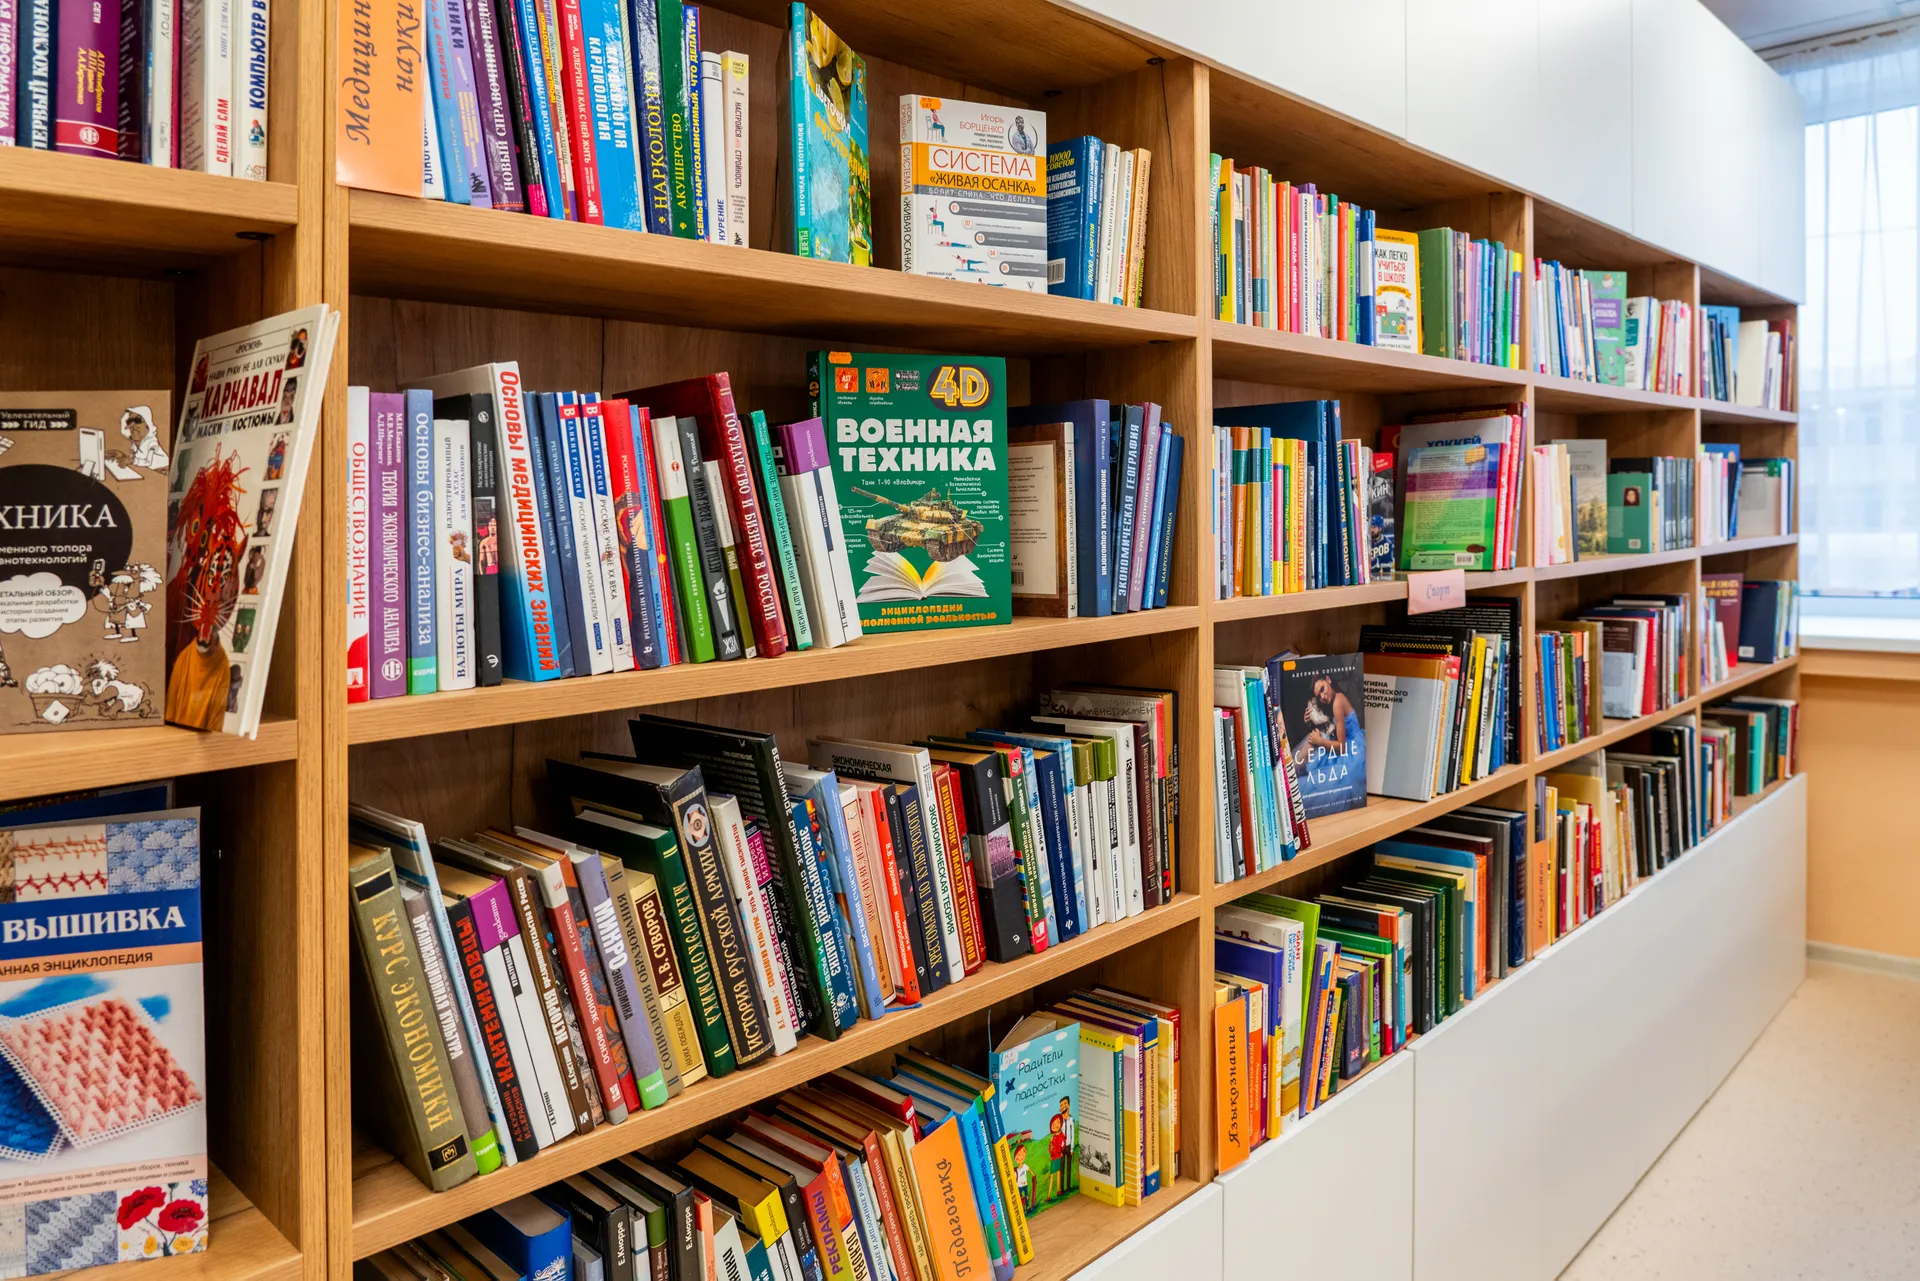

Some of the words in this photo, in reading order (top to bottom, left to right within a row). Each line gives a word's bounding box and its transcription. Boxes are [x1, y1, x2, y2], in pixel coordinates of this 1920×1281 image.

[396, 2, 422, 94] науки
[687, 13, 699, 63] ДЕЛАТЬ?
[249, 13, 266, 110] КОМПЬЮТЕР
[572, 46, 584, 88] АЛЛЕРГИЯ
[690, 64, 699, 87] ЧТО
[217, 98, 229, 116] САМ
[486, 42, 507, 137] СПРАВОЧНИК
[578, 97, 586, 112] КАК
[588, 36, 611, 141] КАРДИОЛОГИЯ
[606, 46, 628, 149] КАРДИОЛОГИЯ
[216, 118, 229, 163] СДЕЛАЙ
[540, 109, 553, 156] ВОЗРАСТА
[580, 121, 589, 138] НЕЙ
[645, 70, 668, 211] НАРКОЛОГИЯ
[734, 101, 742, 138] НАСТРОЙСЯ
[959, 121, 1004, 134] БОРЩЕНКО
[980, 113, 1005, 124] Игорь
[499, 141, 515, 191] НОВЫЙ
[583, 139, 592, 163] ЖИТЬ
[671, 112, 687, 209] АКУШЕРСТВО
[689, 91, 703, 202] НАРКОЗАВИСИМЫЙ.
[902, 147, 911, 191] СИСТЕМА
[932, 148, 1033, 178] СИСТЕМА
[734, 150, 742, 189] СТРОЙНОСТЬ
[929, 172, 979, 189] «ЖИВАЯ
[981, 177, 1036, 194] ОСАНКА»
[928, 187, 955, 196] БОЛИТ
[990, 193, 1005, 201] ЧТО
[1007, 195, 1036, 204] ДЕЛАТЬ
[696, 202, 705, 236] СЕМЬЕ
[717, 198, 726, 241] КУРЕНИЕ
[1377, 260, 1406, 272] УЧИТЬСЯ
[1378, 272, 1383, 281] В
[1384, 272, 1406, 283] ШКОЛЕ
[1388, 249, 1408, 261] ЛЕГКО
[208, 369, 225, 382] НАШИ
[227, 363, 241, 377] РУКИ
[242, 361, 251, 373] НЕ
[251, 357, 264, 371] ДЛЯ
[264, 352, 286, 369] СКУКИ
[929, 364, 990, 407] 4D
[1, 410, 71, 421] Увлекательный
[201, 368, 284, 420] КАРНАВАЛ
[22, 419, 47, 429] ГИД
[197, 418, 223, 439] МАСКИ
[231, 410, 276, 433] КОСТЮМЫ
[836, 418, 993, 443] ВОЕННАЯ
[1426, 435, 1482, 449] ХОККЕЙ
[415, 411, 430, 487] основы
[724, 411, 751, 495] ГОСУДАРСТВО
[838, 447, 996, 472] ТЕХНИКА
[1336, 440, 1344, 482] РОССИИ
[382, 469, 398, 508] ТЕОРИЯ
[570, 456, 583, 495] РУССКИЕ
[593, 454, 605, 492] РУССКИЕ
[499, 371, 524, 451] Основы
[512, 457, 544, 594] медицинских
[529, 599, 560, 672] знаний
[577, 501, 588, 532] РУССКИЕ
[742, 499, 755, 510] И
[1118, 495, 1133, 596] ЭКОНОМИЧЕСКАЯ
[1126, 423, 1140, 490] ГЕОГРАФИЯ
[1338, 487, 1346, 523] МАРКИ
[50, 543, 93, 555] топора
[351, 442, 367, 620] ОБЩЕСТВОЗНАНИЕ
[580, 533, 592, 562] УЧЕНЫЕ
[599, 499, 610, 535] РУССКИЕ
[608, 580, 618, 600] ВЕКА
[745, 511, 765, 555] БИЗНЕС
[1160, 511, 1174, 583] МАКРОЭКОНОМИКА
[1341, 527, 1350, 579] ПОЧТОВЫЕ
[382, 509, 399, 603] ЭКОНОМИЧЕСКОГО
[415, 490, 434, 646] бизнес-анализа
[771, 486, 789, 551] МИРОВОЗЗРЕНИЕ
[795, 607, 807, 636] ЖИЗНЬ
[44, 588, 75, 597] ОБЗОР:
[453, 567, 465, 609] МИРА
[586, 569, 599, 621] ИЗОБРЕТАТЕЛИ
[756, 571, 777, 621] РОССИИ
[1426, 585, 1451, 600] Спорт
[383, 606, 401, 655] АНАЛИЗА
[455, 612, 466, 679] ВАЛЮТЫ
[1292, 670, 1320, 678] АДЕЛИНА
[1322, 666, 1356, 674] СОТНИКОВА
[831, 755, 892, 773] ЭКОНОМИЧЕСКАЯ
[1294, 740, 1359, 765] СЕРДЦЕ
[1306, 765, 1348, 785] ЛЬДА
[1231, 768, 1239, 795] ЯШИН
[1286, 760, 1307, 824] МИШИН
[1233, 797, 1241, 814] ЛЕВ
[515, 876, 530, 904] России
[696, 844, 725, 901] АРМИИ
[770, 746, 793, 817] БЕСШУМНОЕ
[787, 819, 805, 867] ОРУЖИЕ
[797, 869, 821, 943] СПЕЦАГЕНТОВ
[819, 957, 842, 1027] РАЗВЕДЧИКОВ
[851, 826, 876, 922] РОССИЕВЕДЕНИЕ
[929, 803, 949, 895] ЭКОНОМИЧЕСКАЯ
[942, 895, 956, 936] ТЕОРИЯ
[950, 847, 965, 893] ИСТОРИЯ
[766, 882, 785, 935] СИТУАЦИИ
[799, 825, 831, 928] ЭКОНОМИЧЕСКИЙ
[822, 929, 842, 977] АНАЛИЗ
[2, 904, 186, 944] ВЫШИВКА
[617, 892, 652, 983] ОБРАЗОВАНИЯ
[642, 898, 668, 959] СУВОРОВ
[711, 902, 746, 978] РУССКОЙ
[919, 900, 943, 969] ХРЕСТОМАТИЯ
[957, 894, 977, 961] ПОПУЛЯРНАЯ
[42, 952, 153, 974] ЭНЦИКЛОПЕДИЯ
[672, 882, 720, 1027] МАКРОЭКОНОМИКА
[412, 913, 450, 1009] ОРГАНИЗАЦИОННАЯ
[440, 1011, 464, 1060] КУЛЬТУРА
[455, 915, 515, 1084] КАНТЕМИРОВЦЫ
[578, 967, 599, 1025] ЭКОНОМИКИ
[779, 939, 806, 1019] ЭКСТРЕМАЛЬНОЙ
[372, 908, 411, 976] КУРС
[393, 978, 454, 1132] ЭКОНОМИКИ
[542, 987, 570, 1045] ИСТОРИЯ
[639, 984, 674, 1071] СОЦИОЛОГИЯ
[673, 1010, 689, 1046] ПОБЕЖДАТЬ
[731, 981, 764, 1053] ИСТОРИЯ
[594, 1025, 611, 1065] ОСНОВЫ
[1228, 1024, 1241, 1148] Языкознание
[853, 1167, 864, 1198] РАБОТЫ
[873, 1157, 890, 1214] ОБСЛУЖИВАНИЯ
[897, 1166, 912, 1210] ПРОФЕССИЮ
[685, 1205, 693, 1251] Е.Кнорре
[811, 1192, 845, 1276] РЕКЛАМЫ
[858, 1198, 873, 1242] ДИПЛОМНЫЕ
[936, 1157, 972, 1278] Педагогика
[618, 1220, 626, 1267] Е.Кнорре
